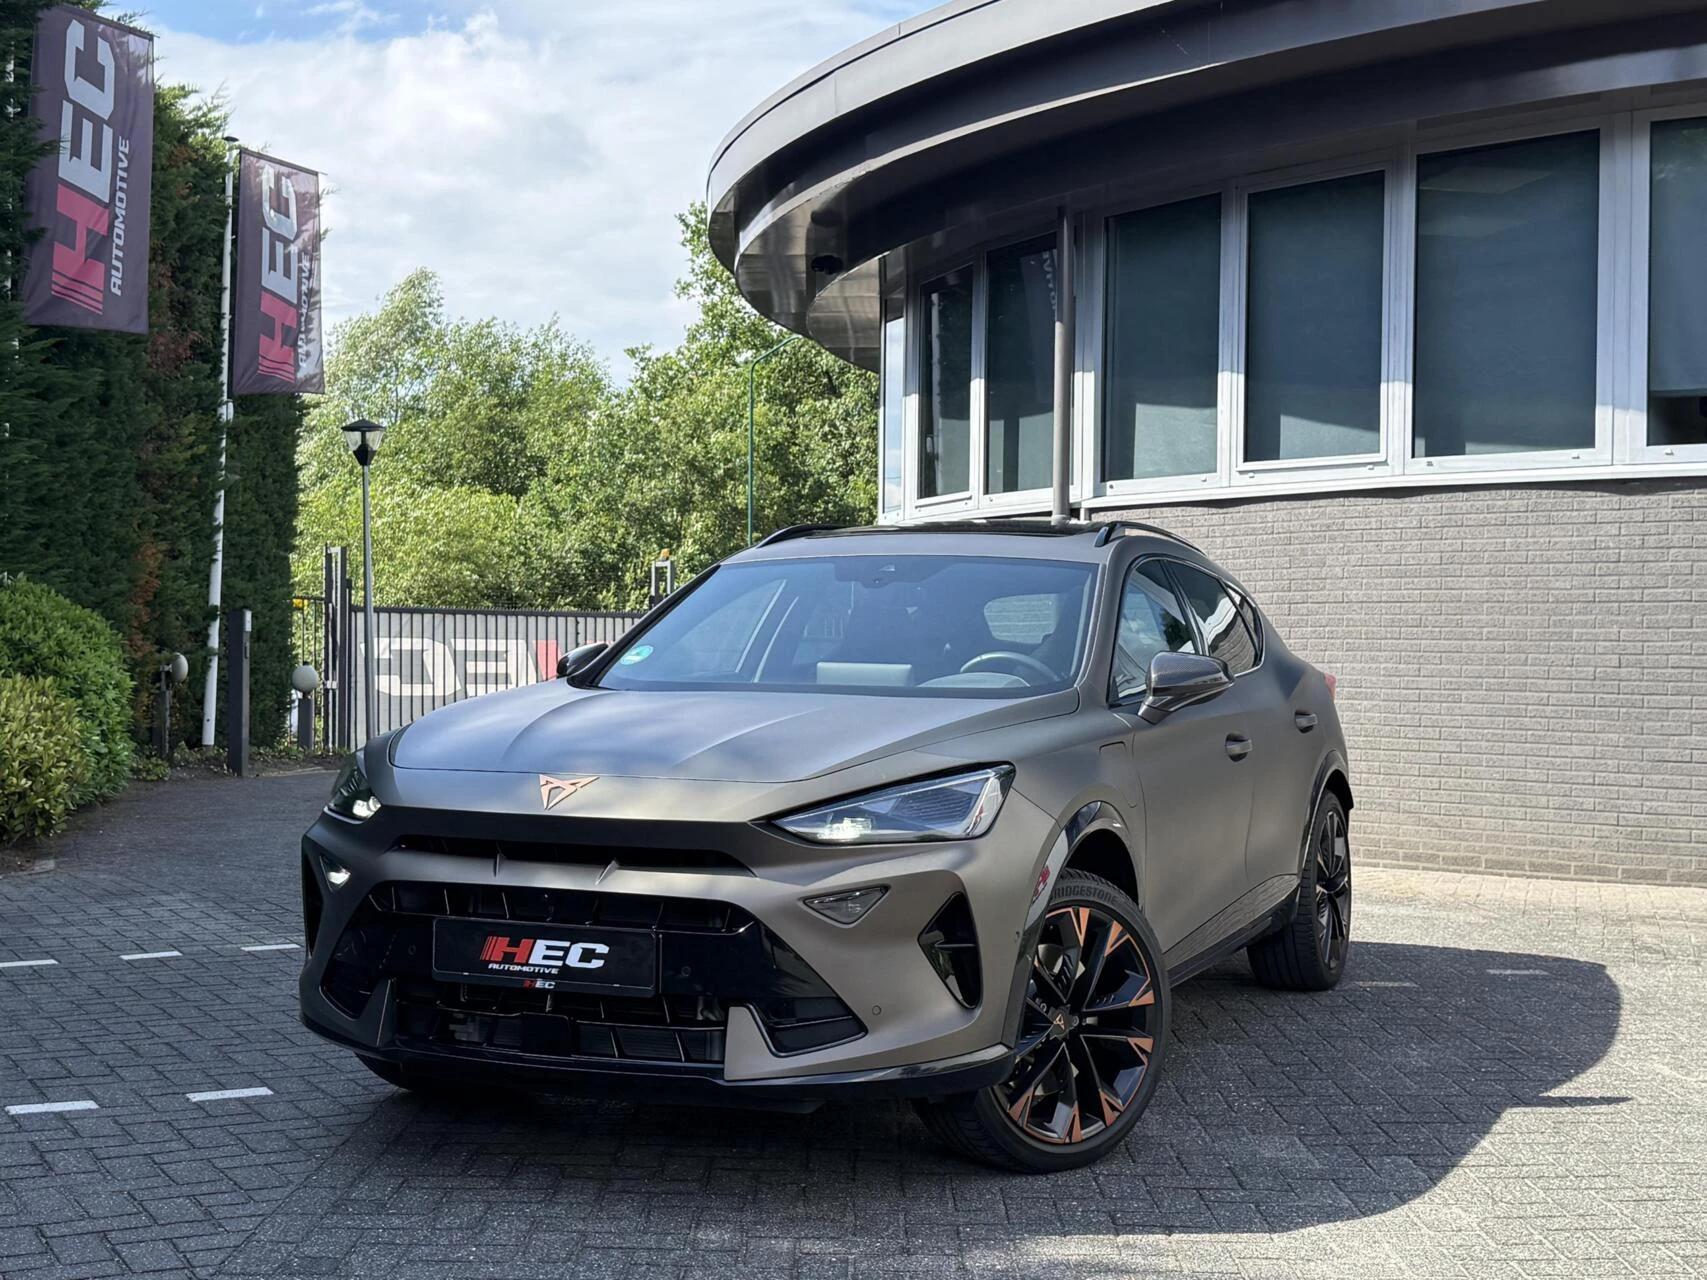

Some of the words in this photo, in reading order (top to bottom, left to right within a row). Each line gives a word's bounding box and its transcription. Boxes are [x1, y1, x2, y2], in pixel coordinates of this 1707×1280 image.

[52, 19, 115, 315] HEC
[110, 136, 130, 296] AUTOMOTIVE
[258, 163, 298, 383] HEC
[1051, 884, 1119, 905] RIDGESTONE
[480, 935, 610, 969] HEC
[488, 962, 559, 974] AUTOMOTIVE
[523, 979, 556, 989] HEC
